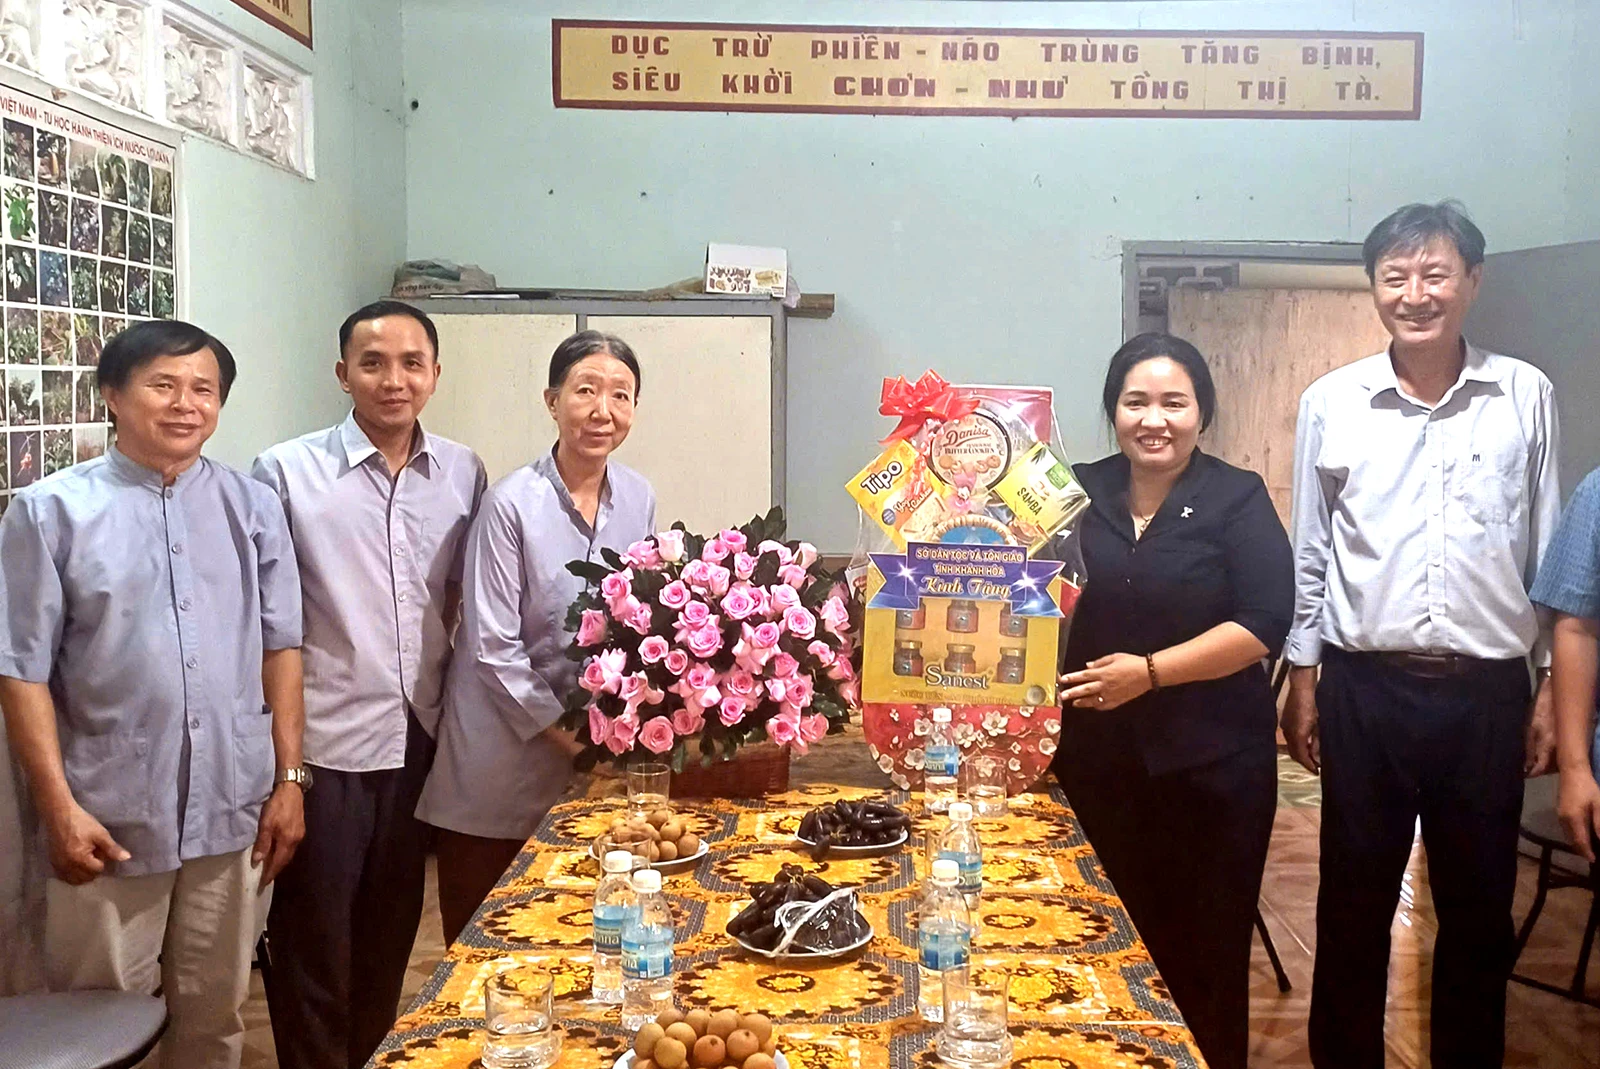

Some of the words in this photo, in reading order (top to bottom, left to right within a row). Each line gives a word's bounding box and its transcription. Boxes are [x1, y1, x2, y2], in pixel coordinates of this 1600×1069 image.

[611, 34, 670, 60] DỤC
[712, 32, 773, 59] TRỪ
[1041, 37, 1139, 64] TRÙNG
[1181, 40, 1260, 65] TĂNG
[1302, 41, 1381, 70] BỊNH,
[611, 66, 681, 93] SIÊU
[987, 75, 1069, 100] NHƯ
[1237, 76, 1287, 106] THỊ
[1335, 74, 1380, 101] TÀ.
[19, 102, 37, 120] NAM
[943, 424, 991, 447] Danisa
[1016, 486, 1043, 516] SAMBA
[925, 663, 989, 690] Sanest
